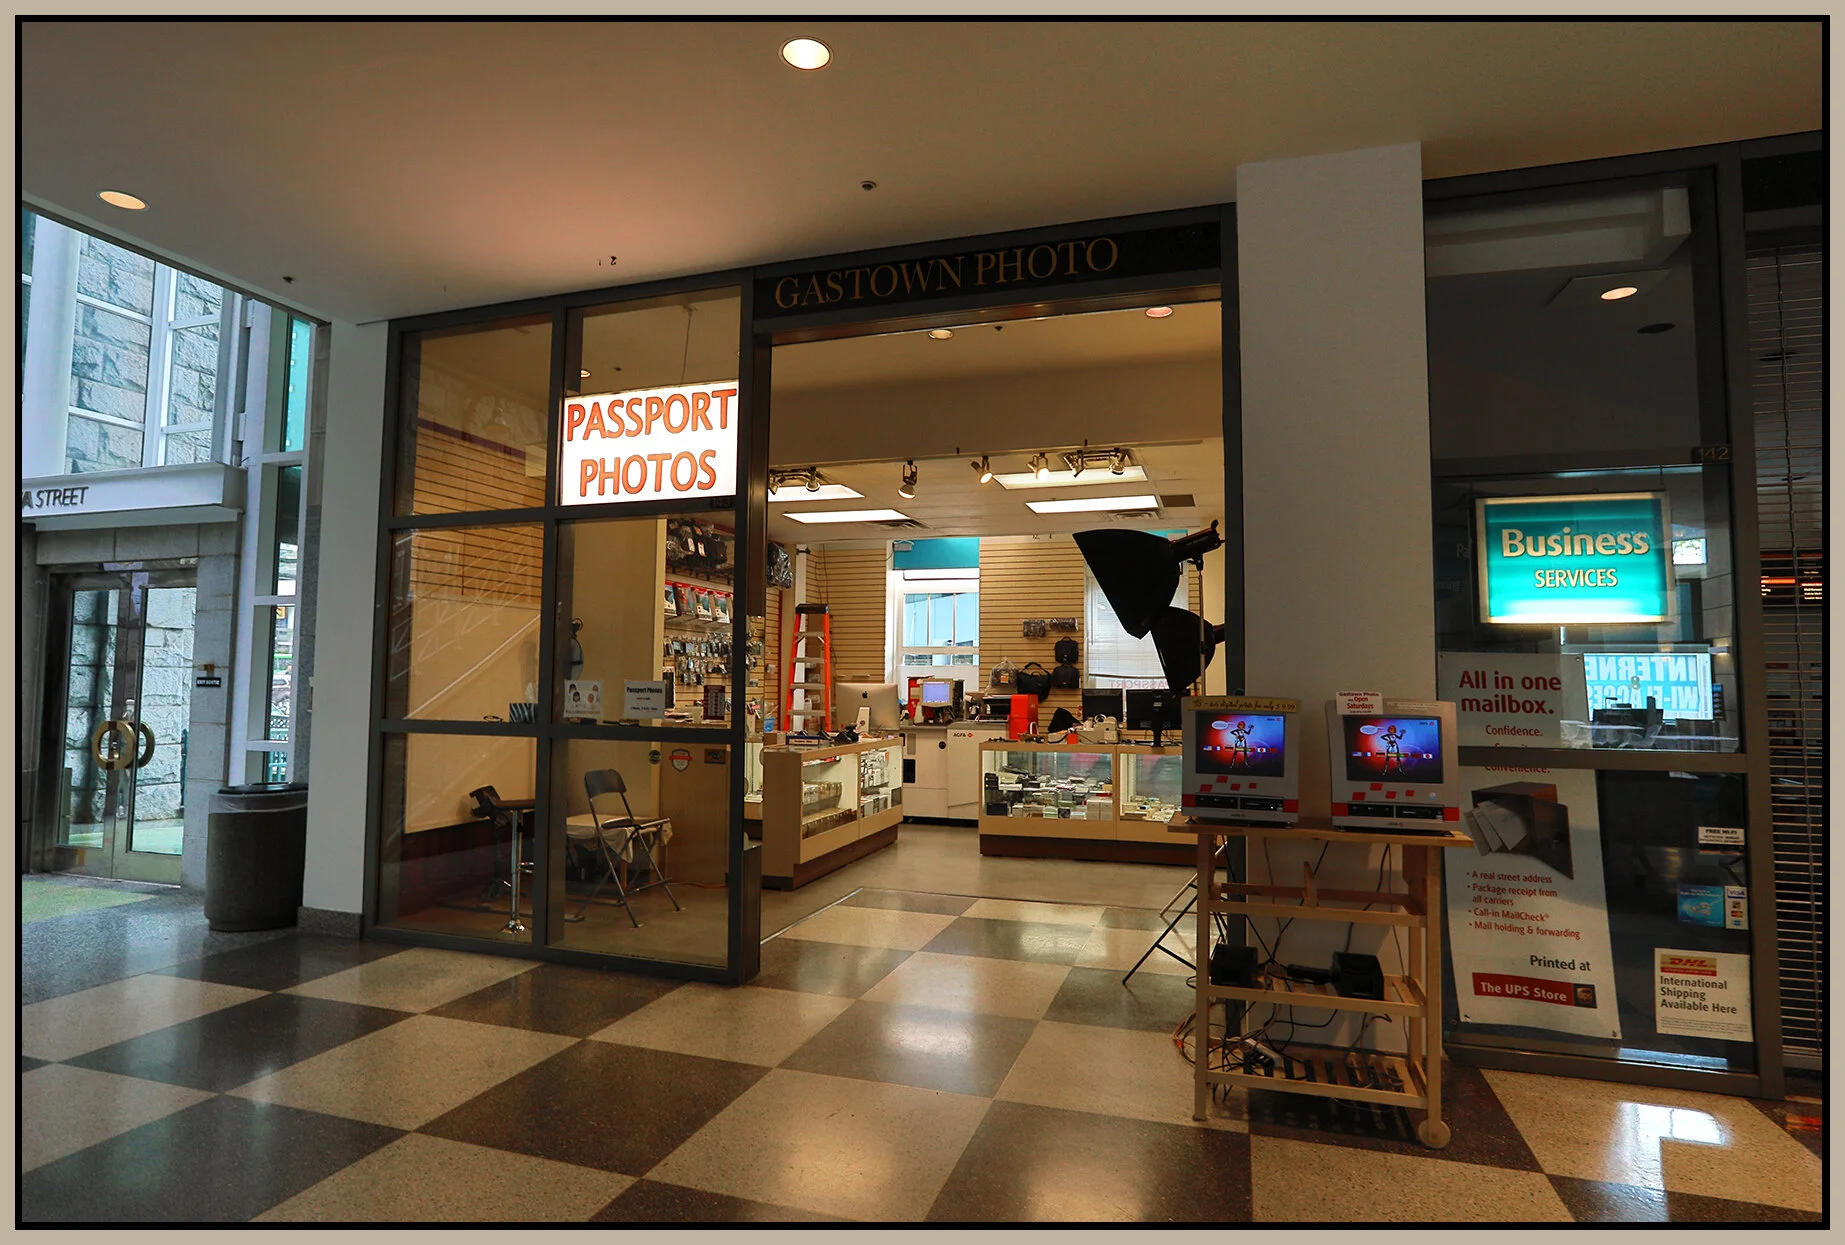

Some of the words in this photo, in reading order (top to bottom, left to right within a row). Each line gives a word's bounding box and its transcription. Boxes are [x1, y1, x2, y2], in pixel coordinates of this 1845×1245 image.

[775, 254, 966, 310] GASTOWN
[974, 236, 1120, 287] PHOTO
[566, 388, 738, 442] PASSPORT
[1698, 446, 1730, 461] 142
[579, 448, 717, 498] PHOTOS
[22, 490, 34, 509] A
[36, 486, 88, 509] STREET
[1501, 526, 1651, 558] Business
[1534, 567, 1619, 589] SERVICES
[1459, 670, 1487, 690] All
[1494, 670, 1514, 690] in
[1521, 675, 1562, 691] one
[1461, 694, 1555, 715] mailbox.
[1485, 724, 1544, 737] Confidence.
[1472, 870, 1479, 879] A
[1480, 871, 1495, 881] real
[1497, 873, 1521, 882] street
[1522, 874, 1553, 884] address
[1472, 883, 1506, 896] Package
[1508, 886, 1537, 897] receipt
[1539, 887, 1558, 898] from
[1472, 895, 1482, 903] all
[1484, 896, 1515, 906] carriers
[1473, 908, 1500, 919] Call-in
[1474, 921, 1493, 931] Mail
[1494, 922, 1526, 936] holding
[1527, 925, 1534, 934] &
[1536, 927, 1581, 940] forwarding
[1529, 954, 1576, 971] Printed
[1579, 961, 1591, 972] at
[1668, 957, 1708, 968] DHL
[1480, 981, 1502, 994] The
[1505, 984, 1530, 997] UPS
[1534, 987, 1567, 1002] Store
[1660, 976, 1728, 990] International
[1660, 987, 1707, 1002] Shipping
[1660, 999, 1709, 1013] Available
[1711, 1003, 1738, 1015] Here
